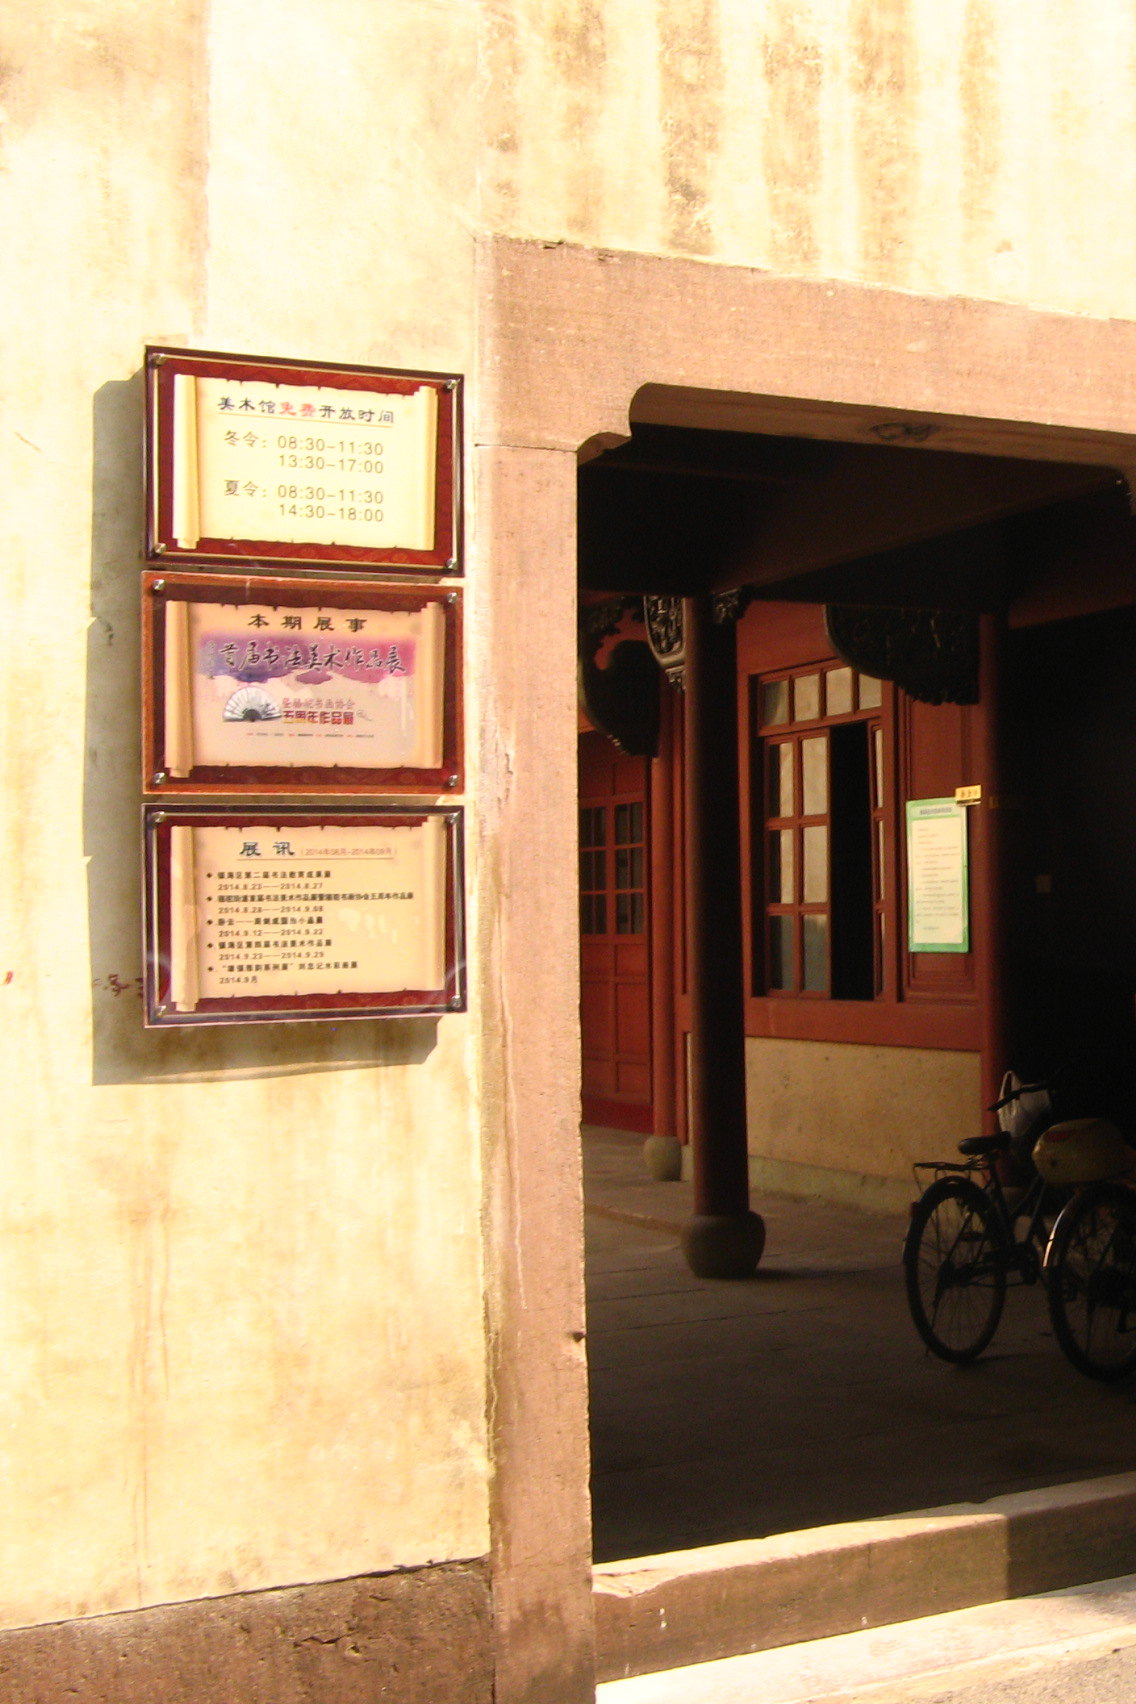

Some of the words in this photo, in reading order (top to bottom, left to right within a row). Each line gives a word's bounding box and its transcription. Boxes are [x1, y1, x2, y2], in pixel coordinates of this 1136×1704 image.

[277, 435, 384, 456] 08:30-11:30
[278, 454, 384, 474] 13:30-17:00
[277, 485, 384, 505] 08:30-11:30
[278, 504, 384, 523] 14:30-18:00
[247, 613, 368, 633] 本期展事
[238, 841, 295, 858] 展讯
